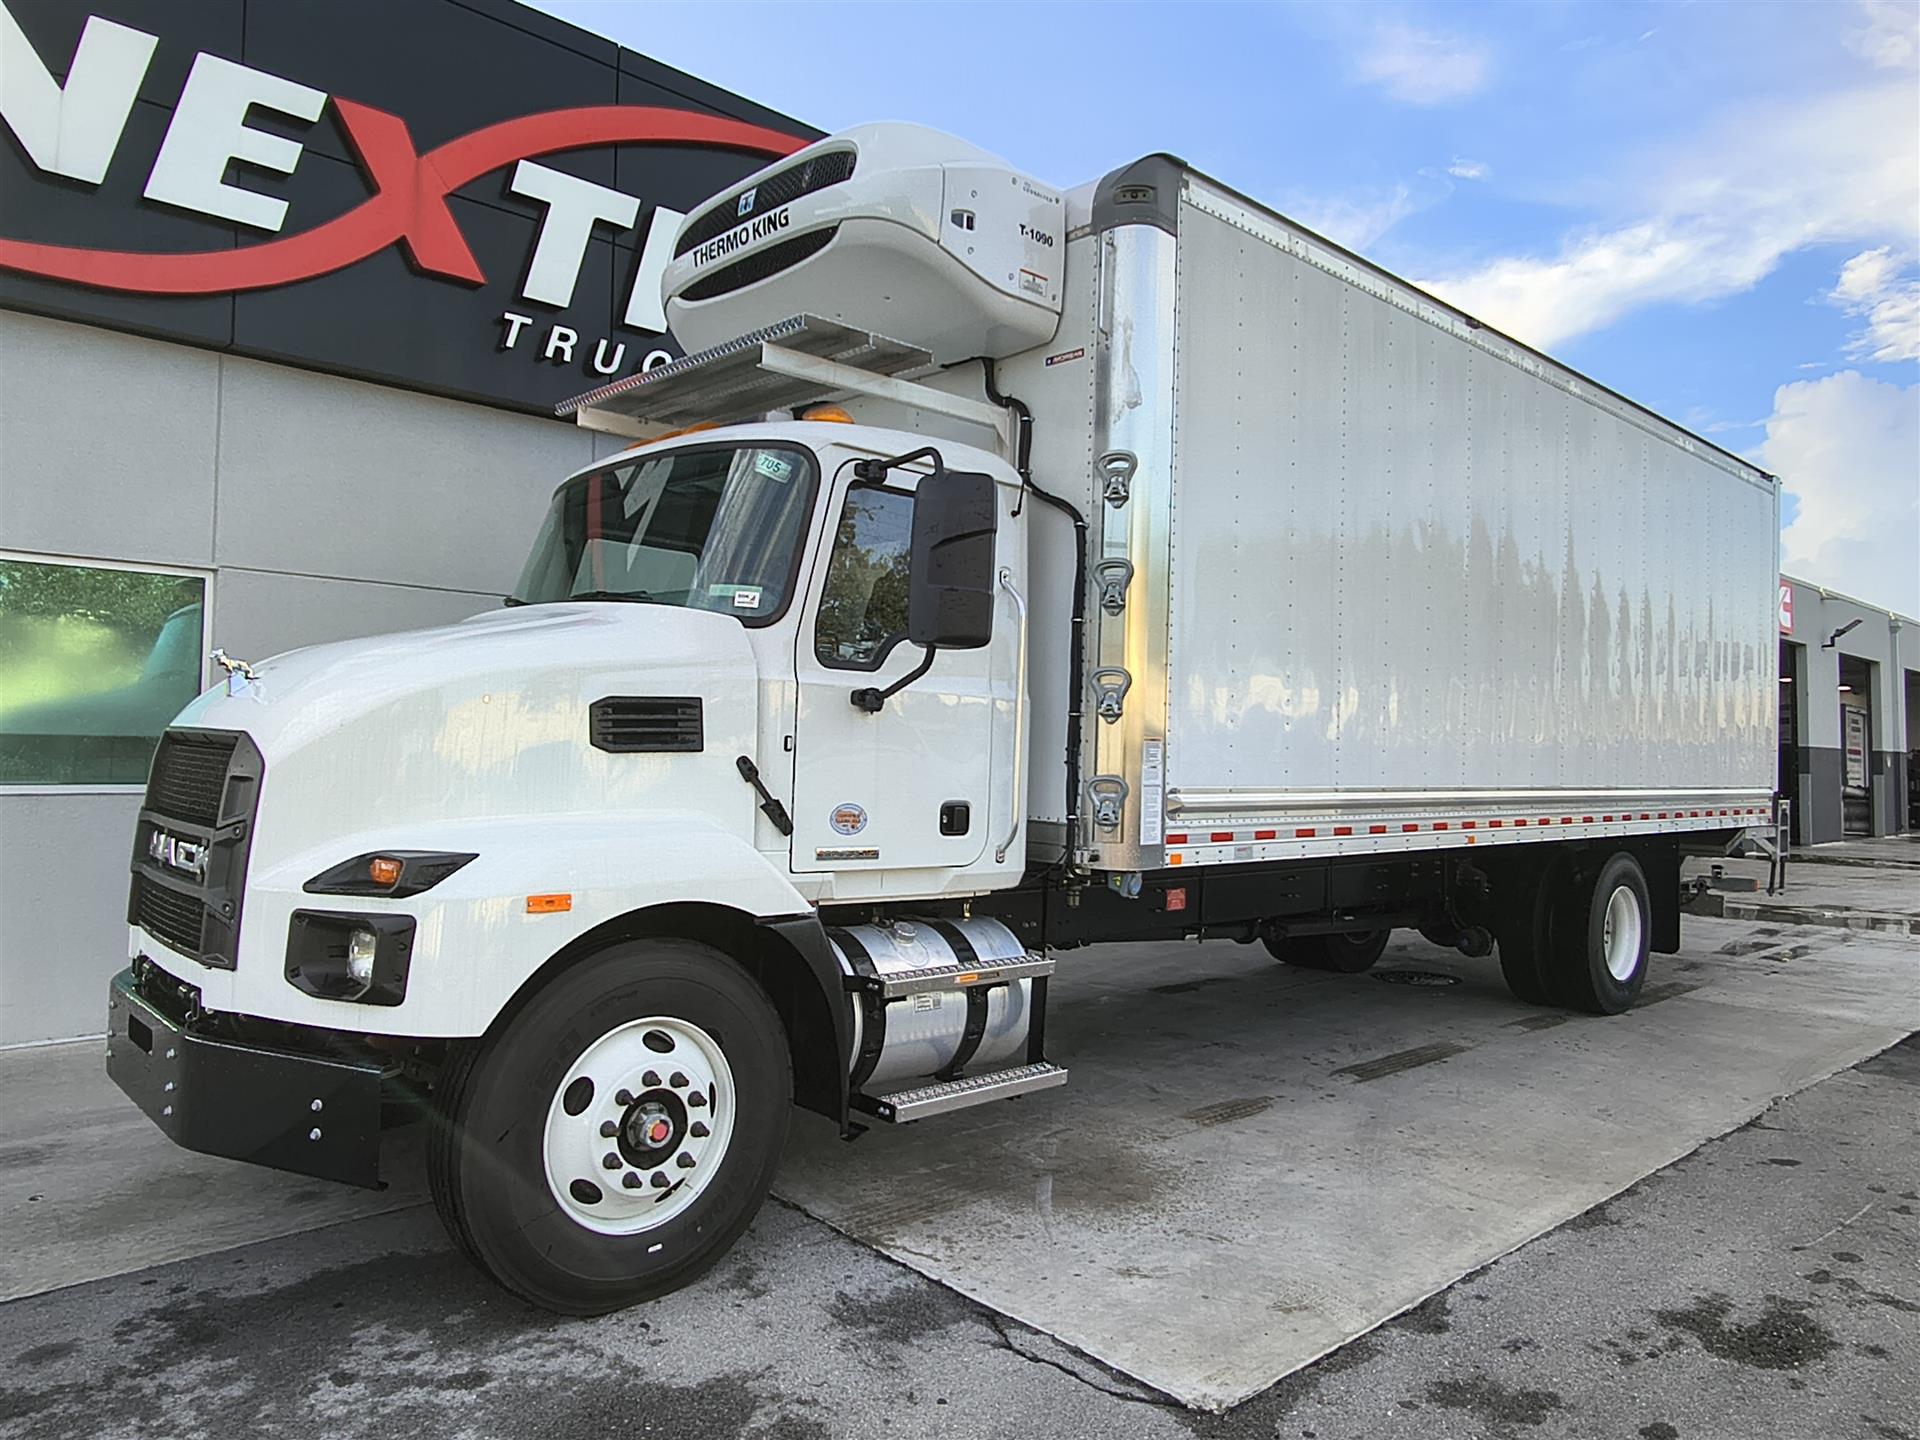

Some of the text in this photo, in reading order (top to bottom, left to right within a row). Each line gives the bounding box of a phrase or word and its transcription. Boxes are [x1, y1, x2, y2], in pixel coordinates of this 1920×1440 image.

[693, 207, 790, 268] THERMO KING
[1019, 222, 1054, 248] T-1090
[760, 456, 782, 473] 705
